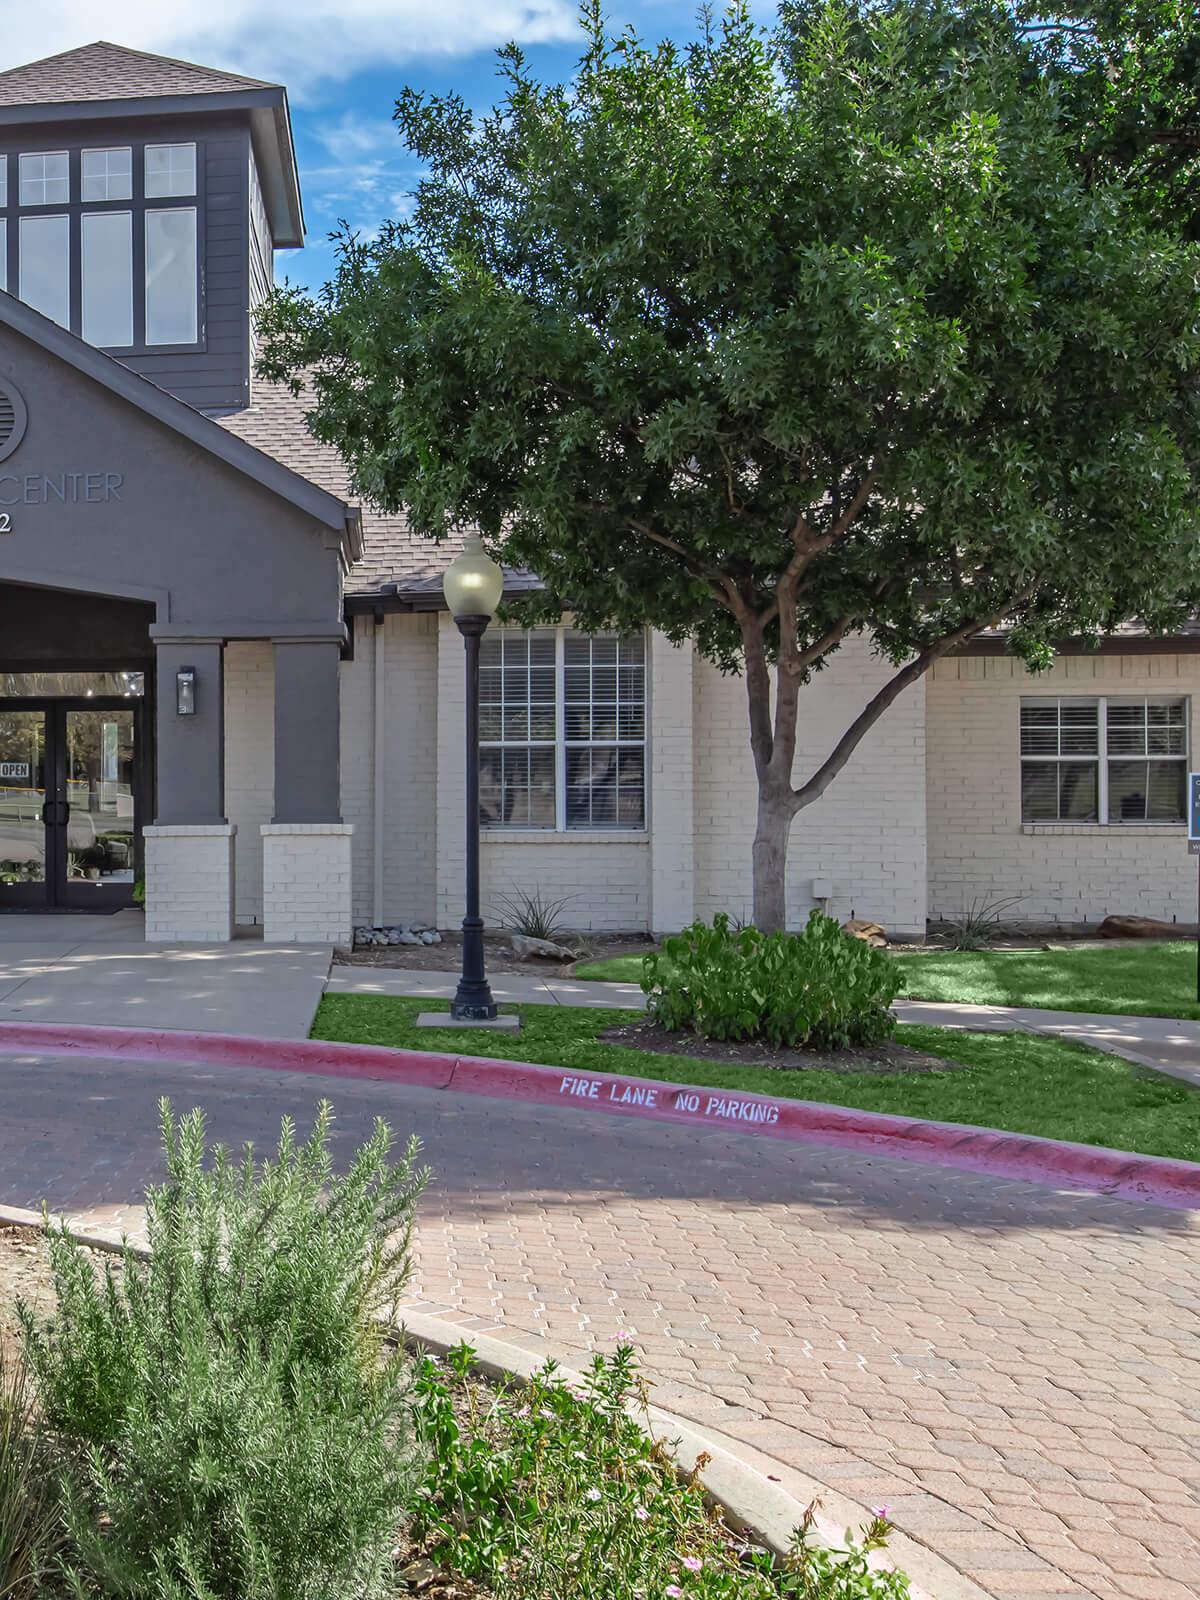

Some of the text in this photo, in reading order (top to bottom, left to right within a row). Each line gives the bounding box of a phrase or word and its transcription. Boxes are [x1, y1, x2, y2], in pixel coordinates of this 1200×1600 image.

[2, 764, 27, 776] OPEN
[559, 1076, 779, 1124] FIRE LANE NO PARKING
